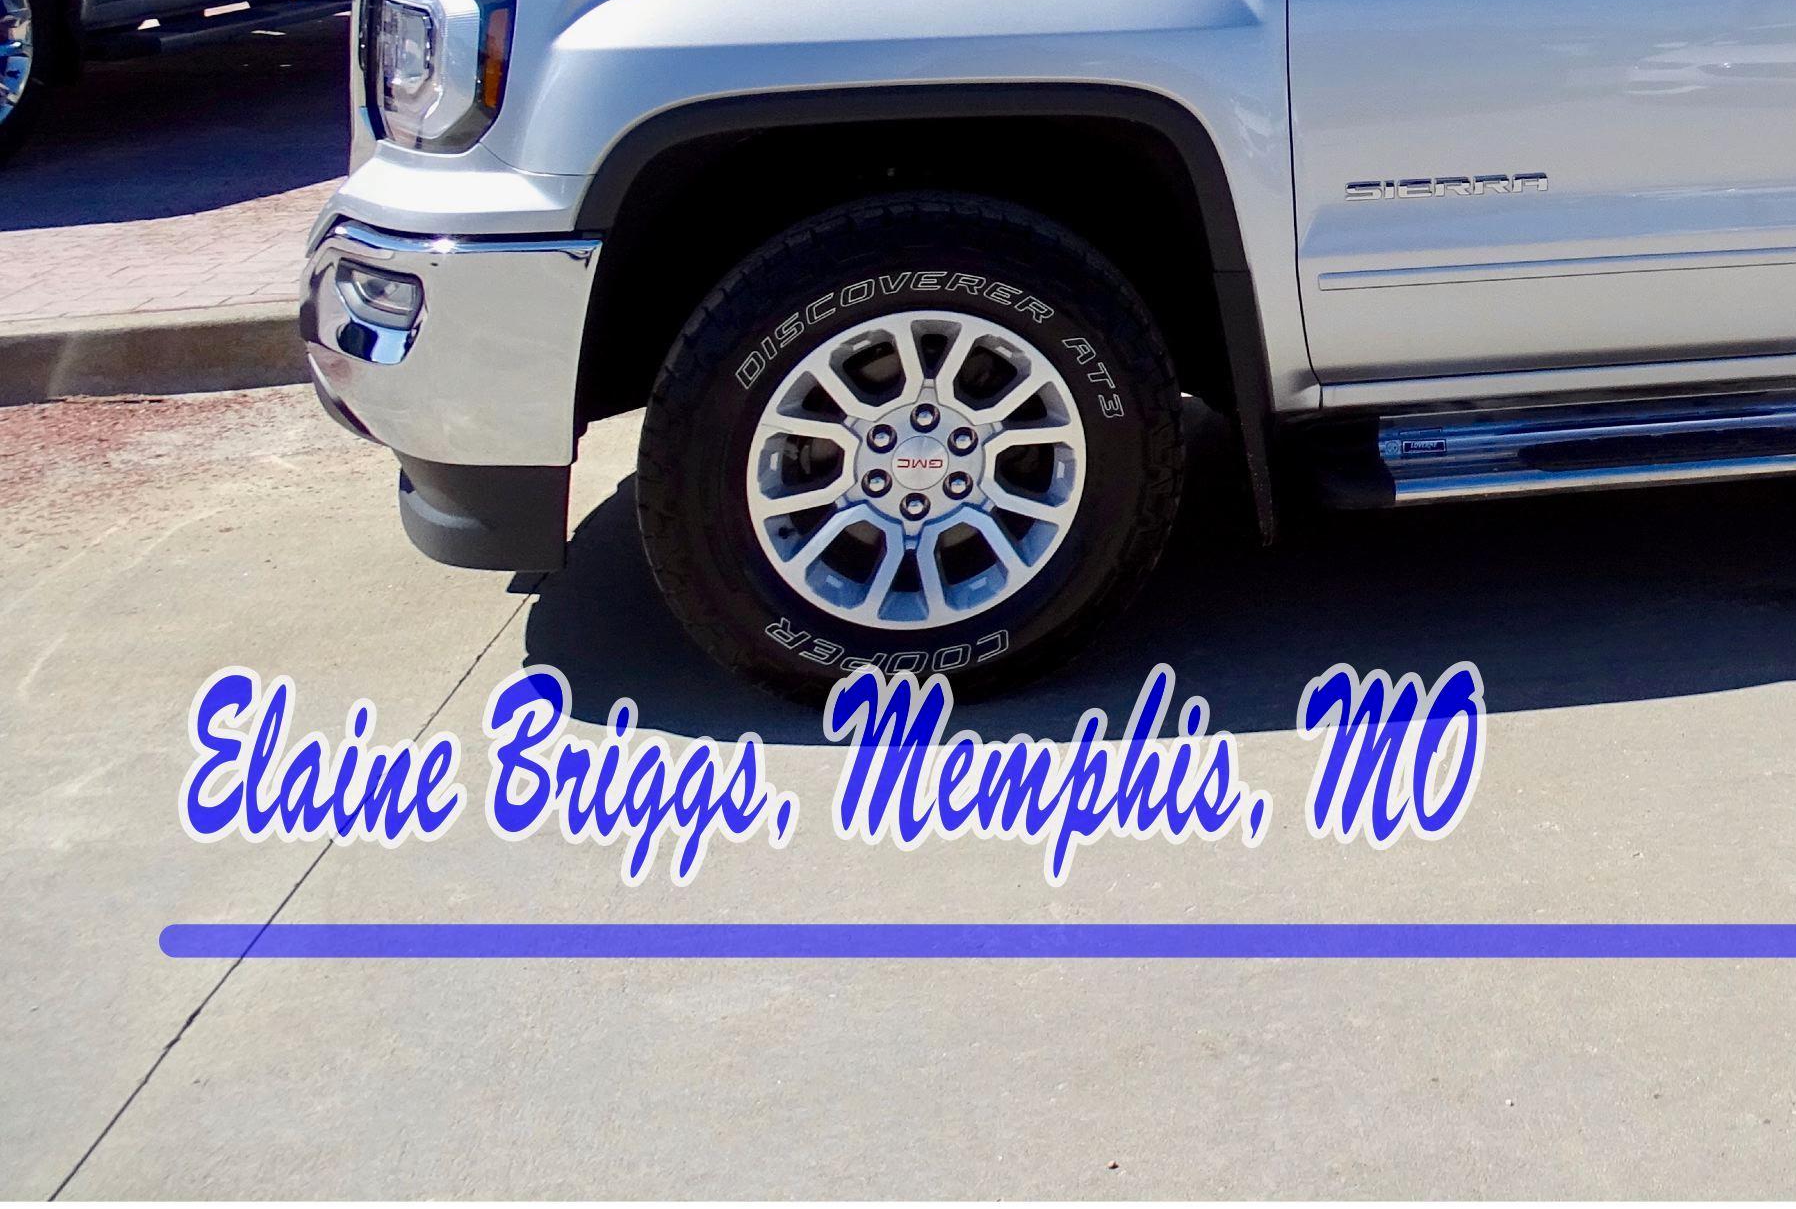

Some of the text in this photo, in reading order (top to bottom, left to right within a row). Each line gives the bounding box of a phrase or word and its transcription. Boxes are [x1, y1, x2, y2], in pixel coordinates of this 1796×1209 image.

[1345, 171, 1550, 202] SIERRA
[734, 271, 1125, 419] DISCOVERER AT3
[896, 458, 943, 469] GMC
[765, 617, 1009, 676] COOPER
